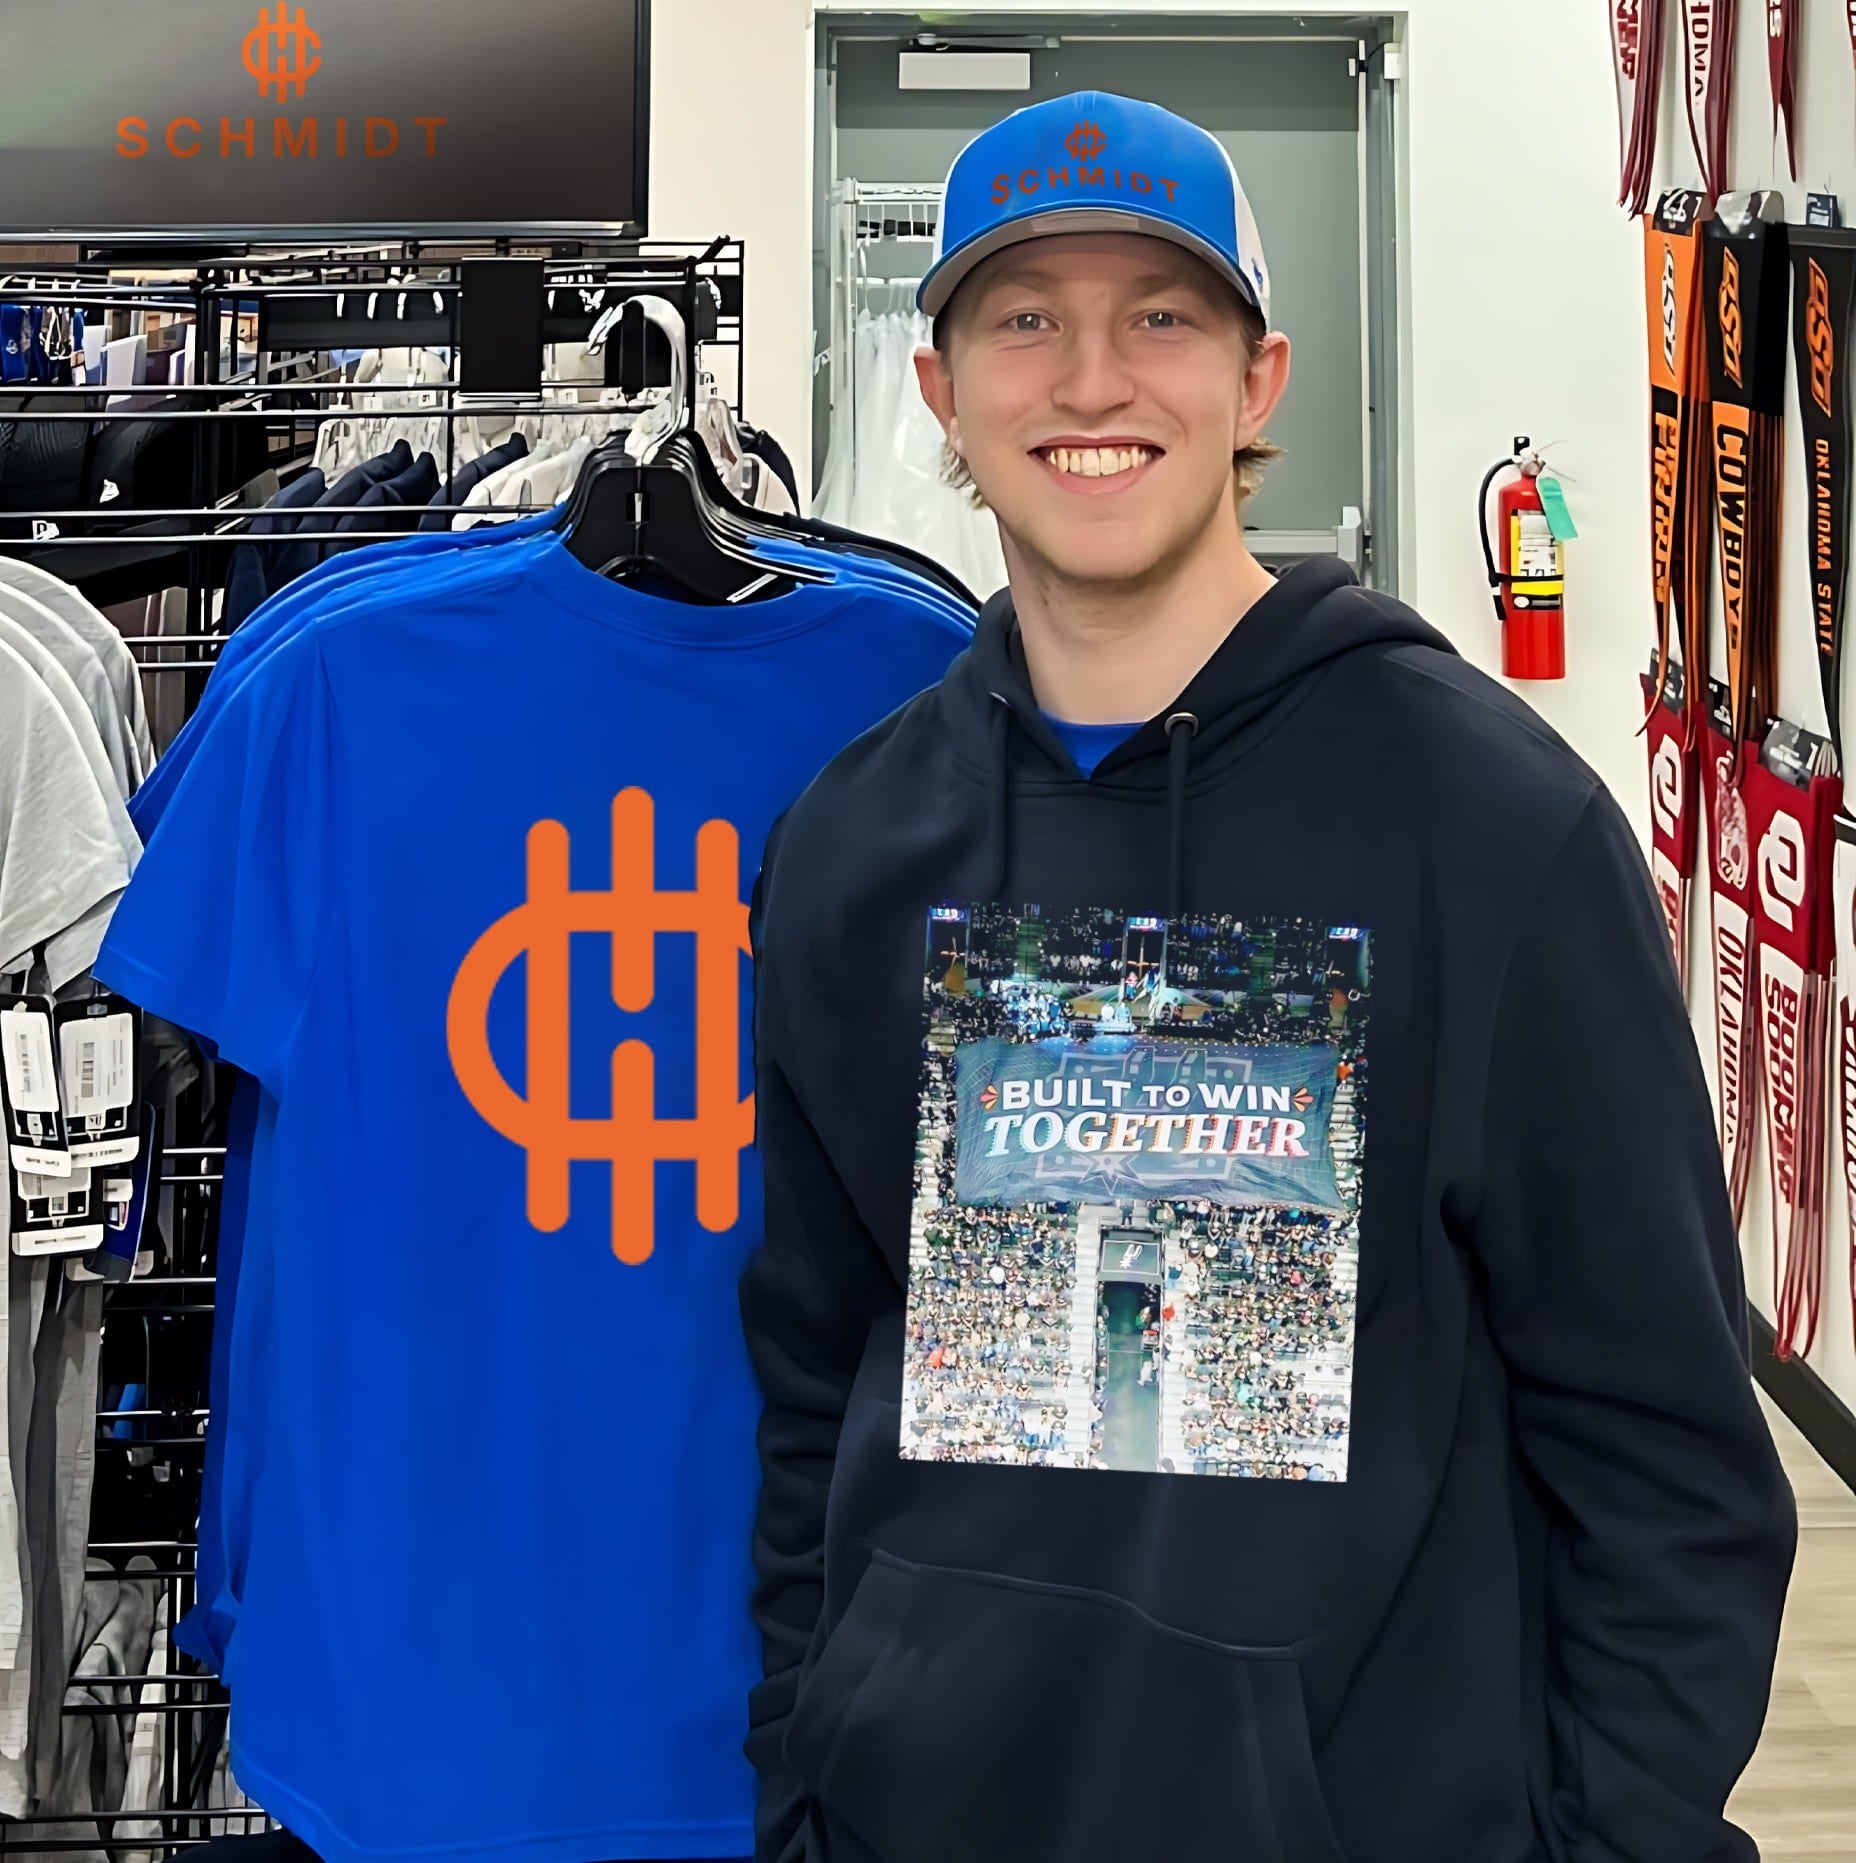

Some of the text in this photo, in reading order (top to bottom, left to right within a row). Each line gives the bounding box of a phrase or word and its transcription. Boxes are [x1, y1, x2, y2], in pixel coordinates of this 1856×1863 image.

[115, 116, 448, 159] SCHMIDT
[991, 167, 1179, 204] SCHMIDT
[1815, 438, 1834, 657] OKLAHOMA STATE
[1002, 1078, 1291, 1111] BUILT TO WIN
[984, 1111, 1310, 1159] TOGETHER
